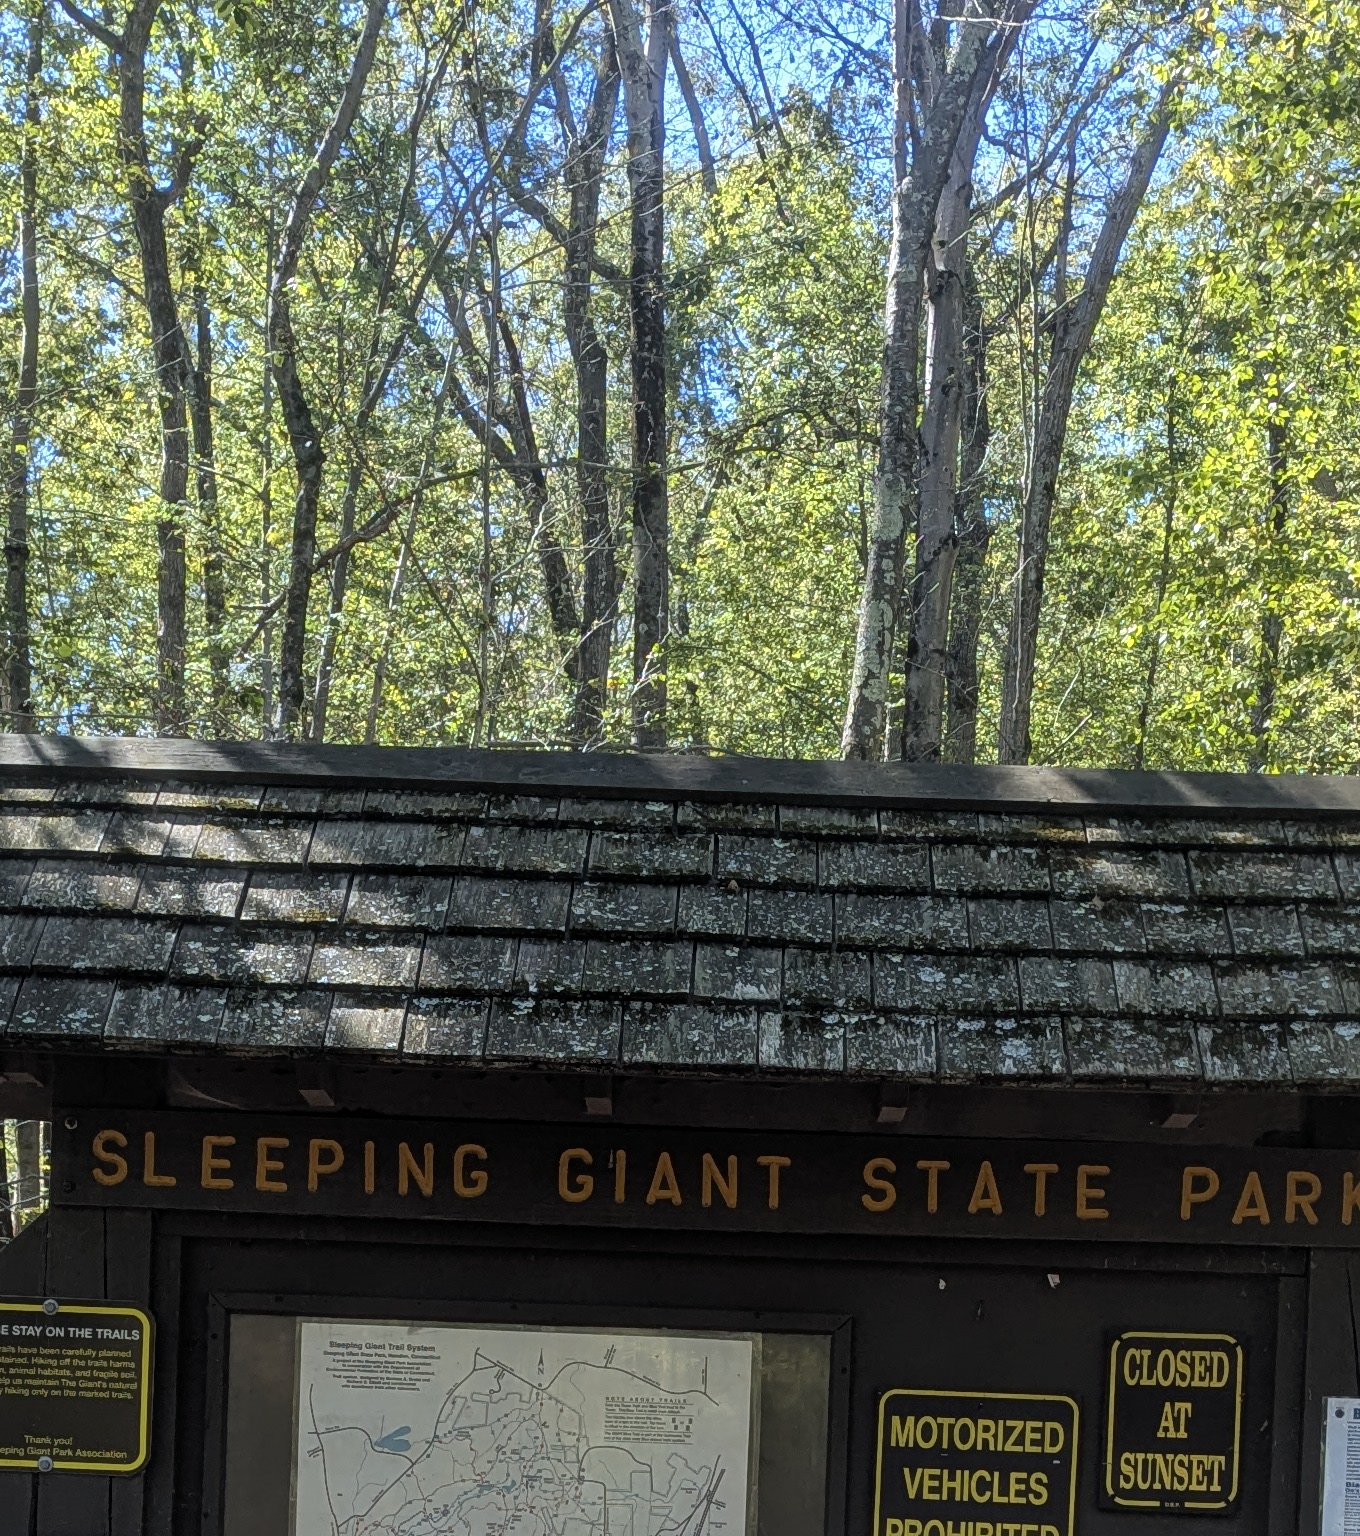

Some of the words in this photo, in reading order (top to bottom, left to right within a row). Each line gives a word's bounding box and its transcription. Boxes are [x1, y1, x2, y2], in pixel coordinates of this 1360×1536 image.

[92, 1128, 489, 1199] SLEEPING
[557, 1147, 791, 1210] GIANT
[860, 1156, 1110, 1220] STATE
[12, 1325, 43, 1337] STAY
[45, 1326, 65, 1338] ON
[68, 1327, 93, 1339] THE
[95, 1328, 140, 1340] TRAILS
[17, 1346, 37, 1354] have
[39, 1347, 60, 1355] been
[61, 1348, 97, 1358] carefully
[98, 1349, 132, 1358] planned
[31, 1356, 58, 1366] Hiking
[72, 1358, 86, 1366] the
[1123, 1347, 1230, 1388] CLOSED
[8, 1367, 36, 1375] animal
[75, 1369, 91, 1377] and
[24, 1378, 60, 1386] maintain
[108, 1381, 138, 1390] natural
[4, 1386, 30, 1396] hiking
[31, 1388, 49, 1397] only
[50, 1389, 62, 1397] on
[63, 1389, 77, 1397] the
[1157, 1401, 1192, 1439] AT
[24, 1434, 52, 1445] Thank
[890, 1415, 1065, 1454] MOTORIZED
[26, 1446, 51, 1456] Giant
[52, 1447, 74, 1457] Park
[75, 1448, 128, 1459] Association
[1119, 1451, 1226, 1492] SUNSET
[903, 1467, 1049, 1506] VEHICLES
